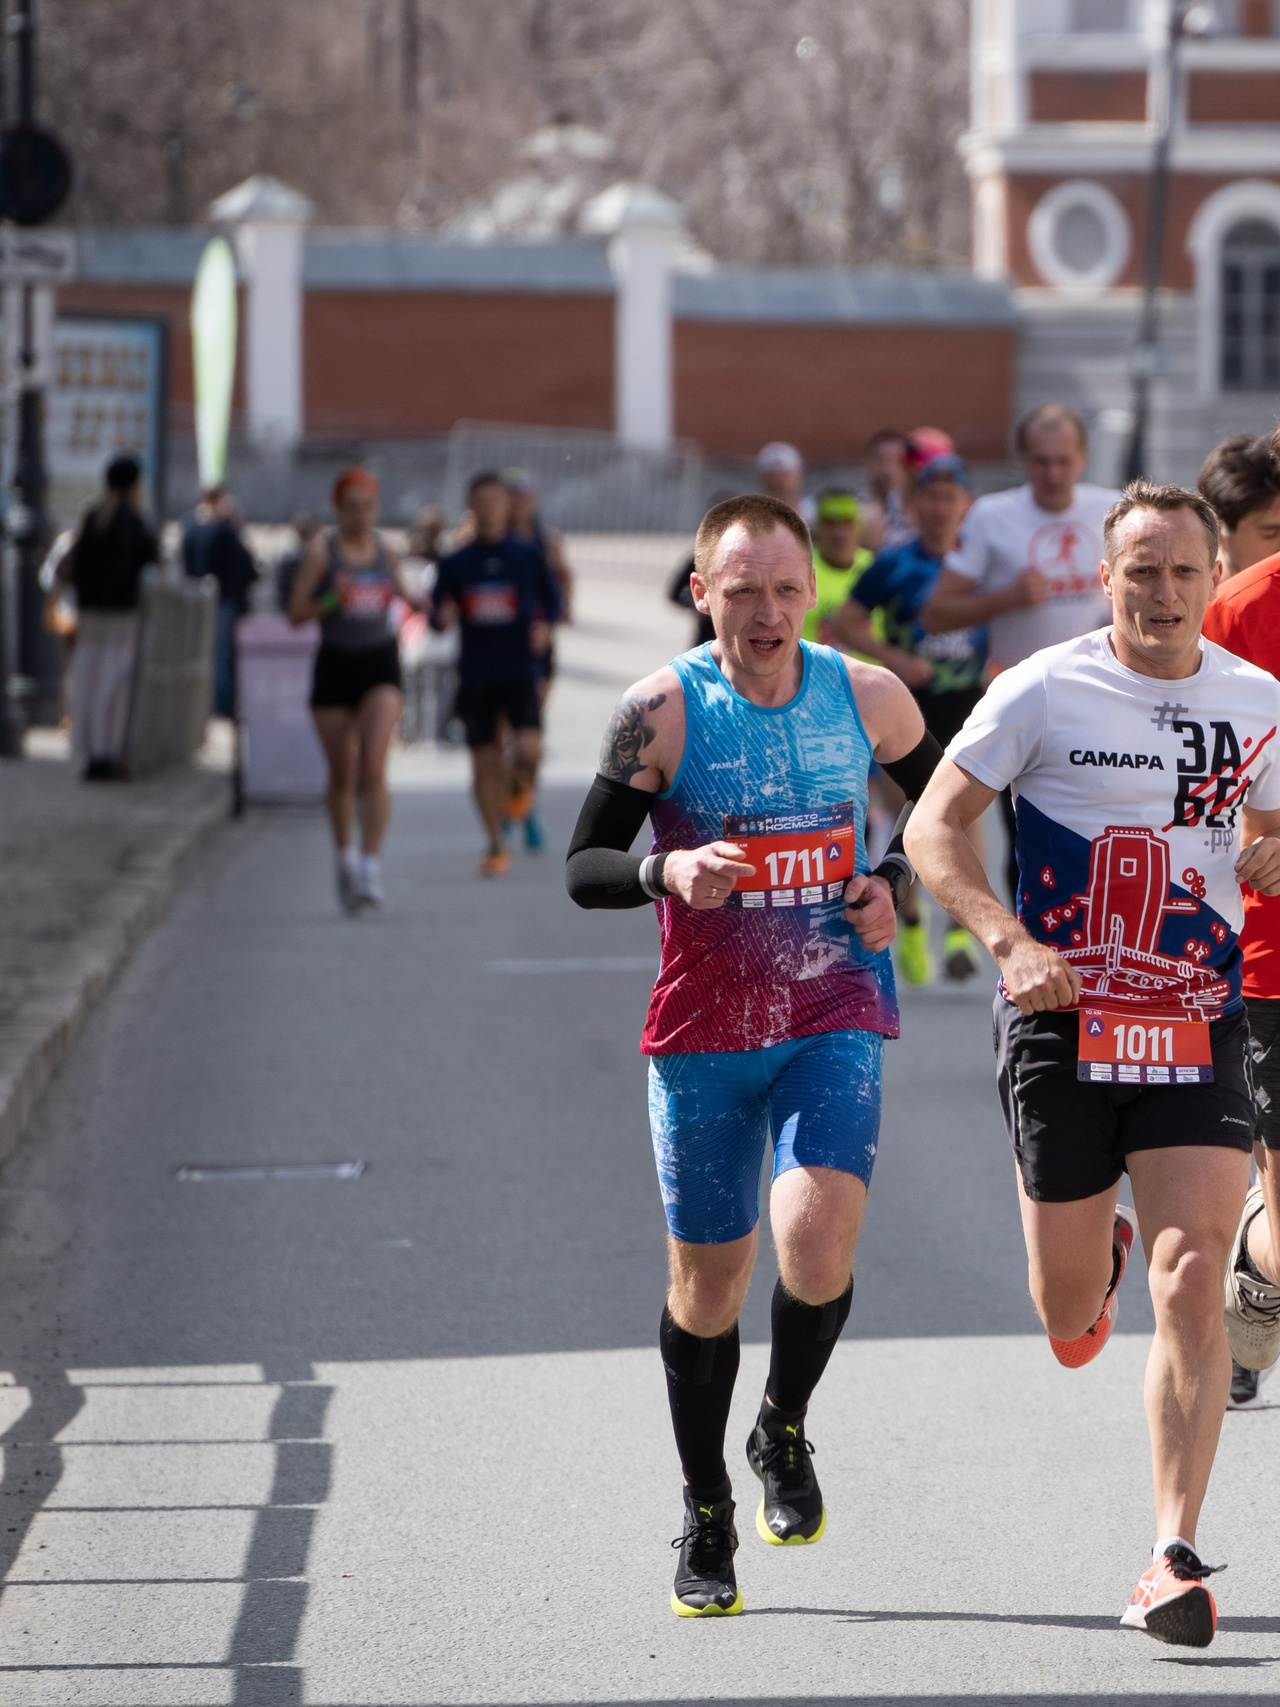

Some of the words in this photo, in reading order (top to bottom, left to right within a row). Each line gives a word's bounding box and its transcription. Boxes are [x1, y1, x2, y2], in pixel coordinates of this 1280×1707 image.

[1069, 749, 1165, 771] САМАРА
[765, 819, 819, 831] КОСМОС
[774, 813, 818, 823] ПРОСТО
[765, 847, 825, 886] 1711
[1113, 1024, 1174, 1062] 1011
